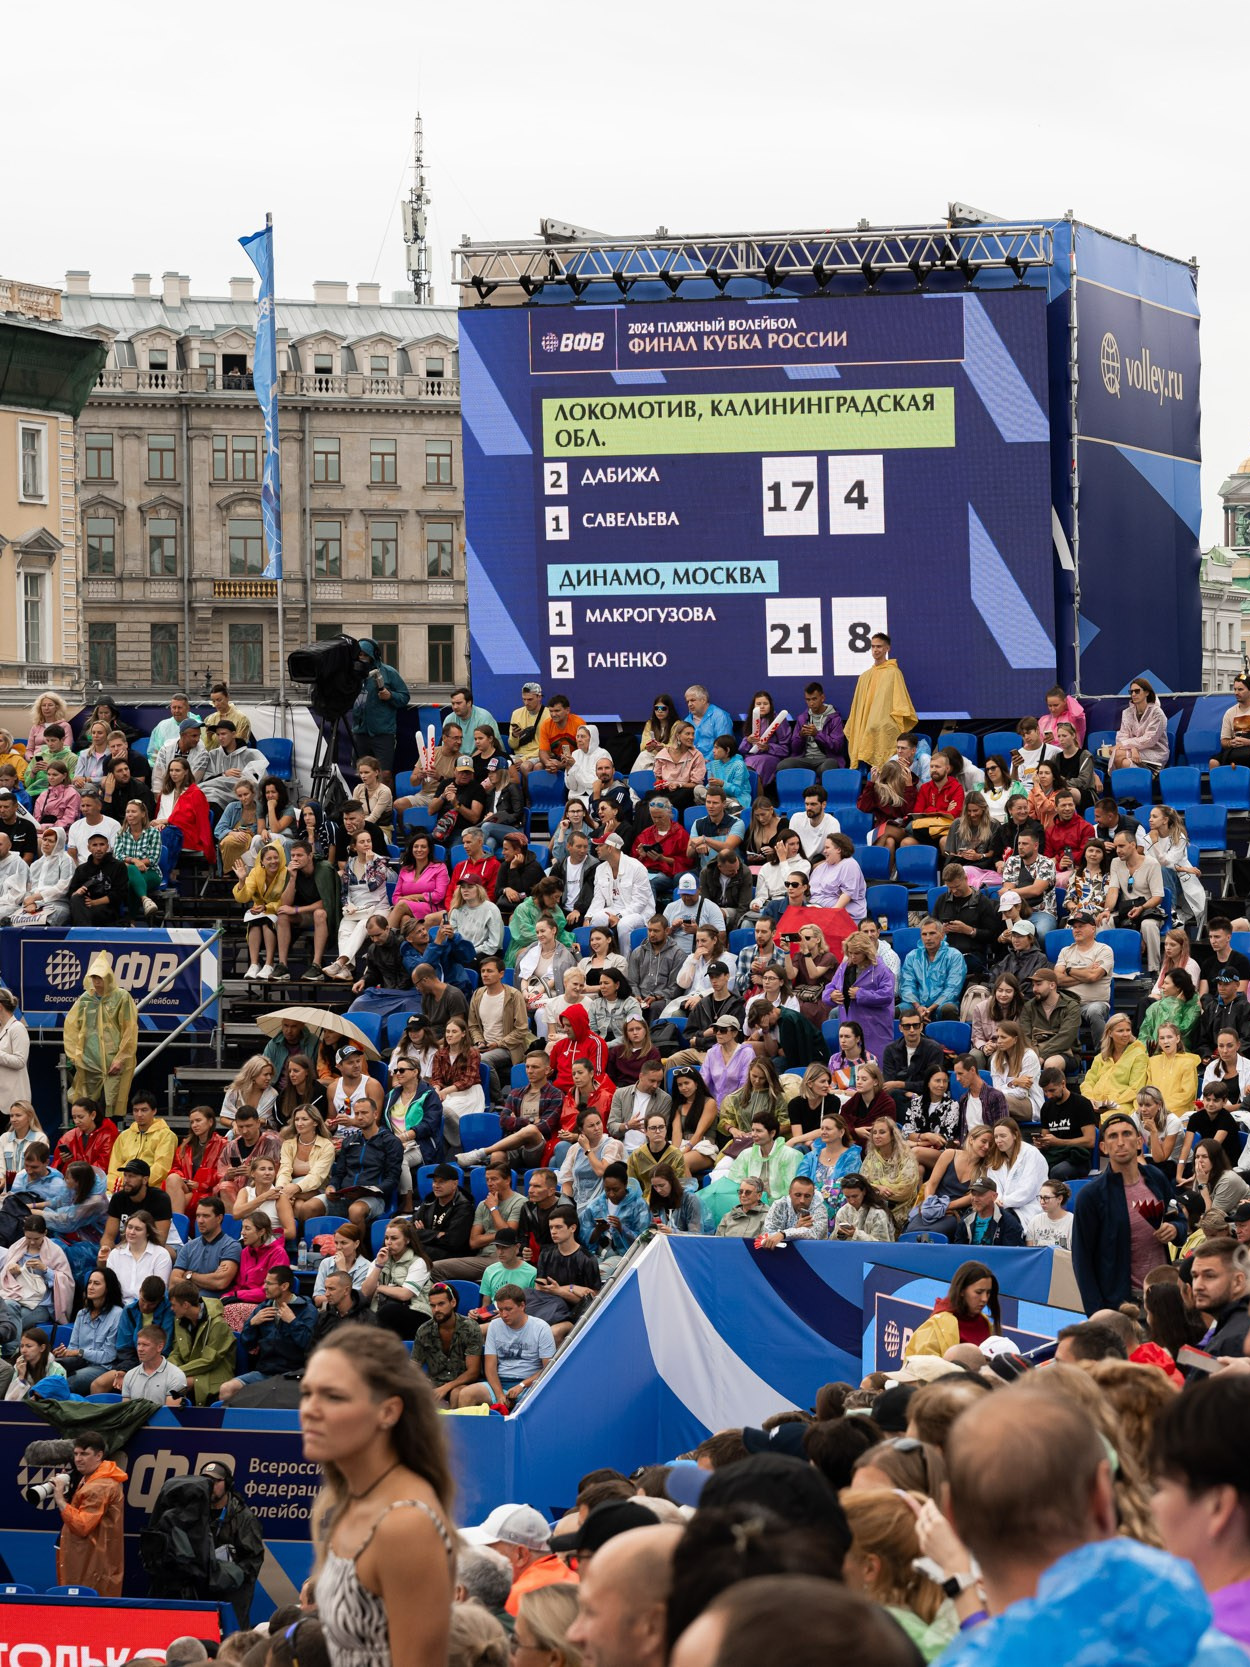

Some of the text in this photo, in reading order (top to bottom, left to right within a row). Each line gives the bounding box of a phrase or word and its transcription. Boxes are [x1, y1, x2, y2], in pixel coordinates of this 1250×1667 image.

[628, 316, 797, 334] 2024 ПЛЯЖНЫЙ ВОЛЕЙБОЛ
[560, 332, 605, 352] ВФВ
[628, 330, 848, 354] ФИНАЛ КУБКА РОССИИ
[1125, 347, 1184, 406] volley.ru
[554, 394, 935, 422] ЛОКОМОТИВ, КАЛИНИНГРАДСКАЯ
[555, 428, 606, 448] ОБЛ.
[550, 466, 660, 489] 2 ДАБИЖА
[767, 479, 869, 512] 17 4
[552, 511, 679, 532] 1 САВЕЛЬЕВА
[559, 567, 767, 591] ДИНАМО, МОСКВА
[555, 606, 717, 627] 1 МАКРОГУЗОВА
[769, 622, 872, 654] 21 8
[556, 652, 668, 672] 2 ГАНЕНКО
[44, 994, 81, 1003] Всеросси
[248, 1457, 325, 1477] Всеросси
[244, 1480, 322, 1499] федерац
